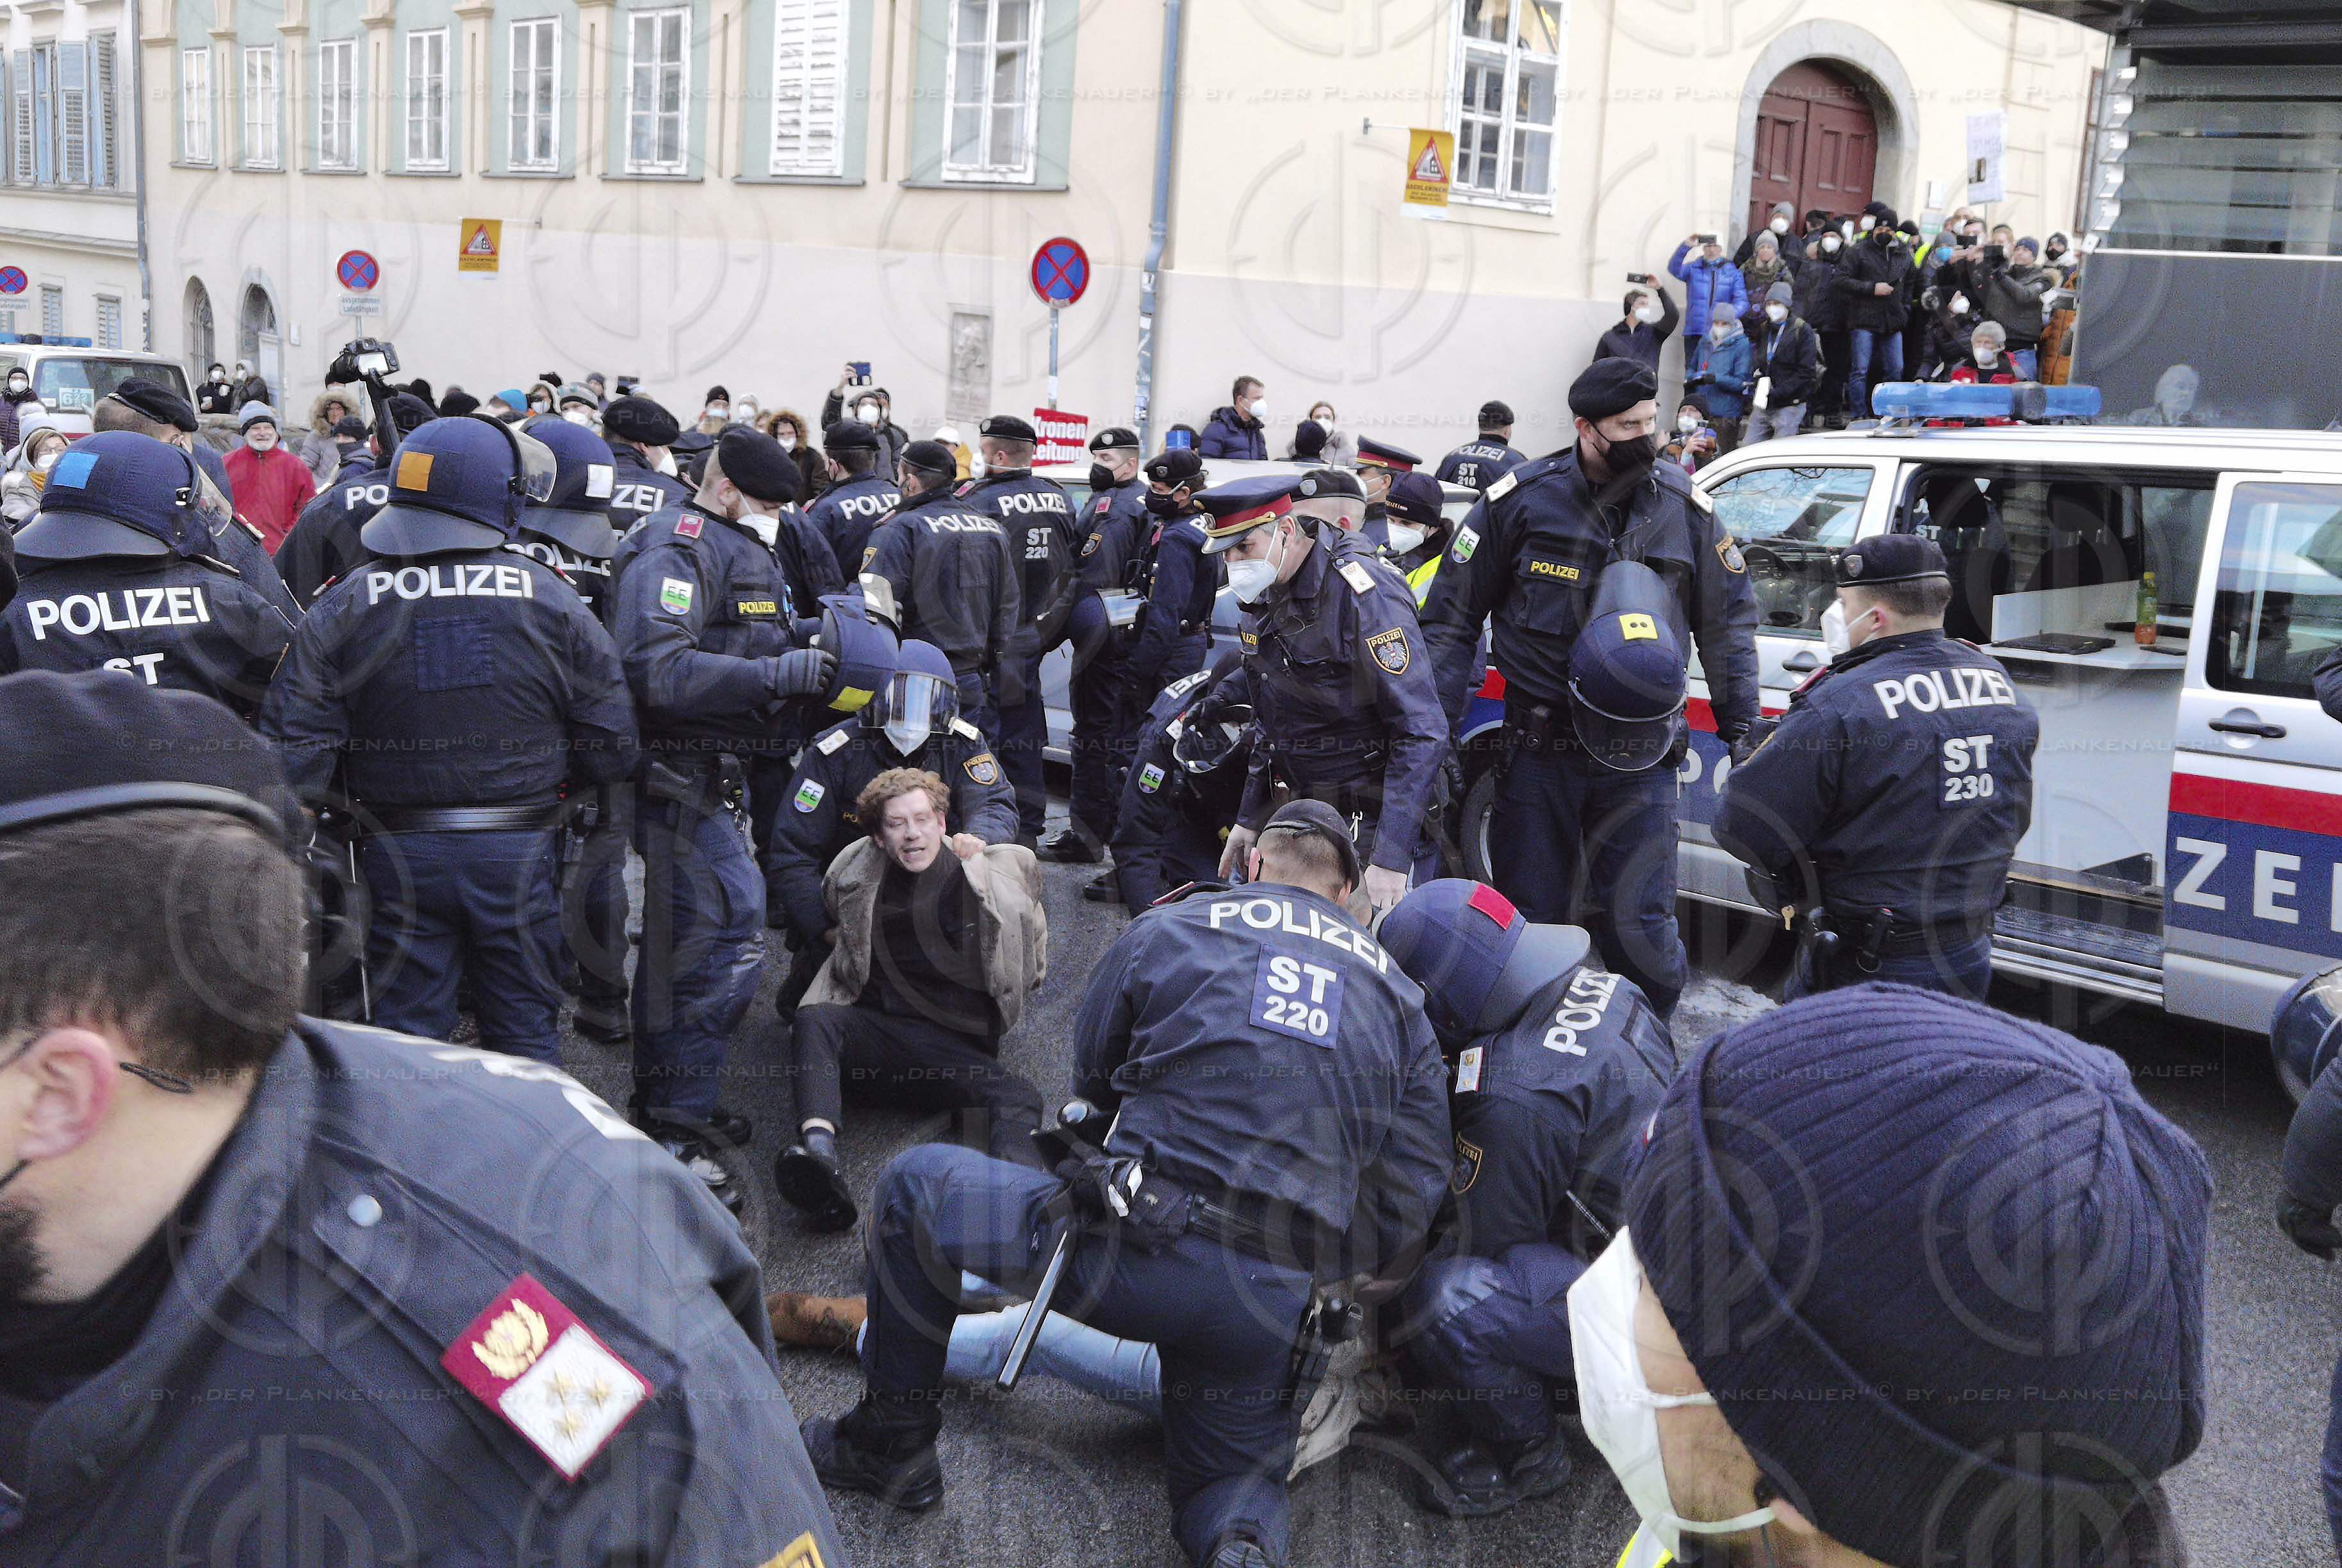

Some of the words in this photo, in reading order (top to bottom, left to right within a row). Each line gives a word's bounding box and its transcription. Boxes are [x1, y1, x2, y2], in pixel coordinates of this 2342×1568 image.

[1457, 476, 1477, 487] 210
[1459, 462, 1478, 477] ST
[1027, 527, 1052, 546] ST
[1025, 546, 1049, 559] 220
[367, 564, 534, 605] POLIZEI
[1530, 560, 1580, 580] POLIZEI
[26, 586, 211, 641] POLIZEI
[737, 601, 777, 614] POLIZEI
[1943, 734, 1994, 773] ST
[1944, 773, 1995, 802] 230
[1209, 899, 1389, 974] POLIZEI
[1266, 956, 1338, 1004] ST
[1262, 994, 1329, 1036] 220
